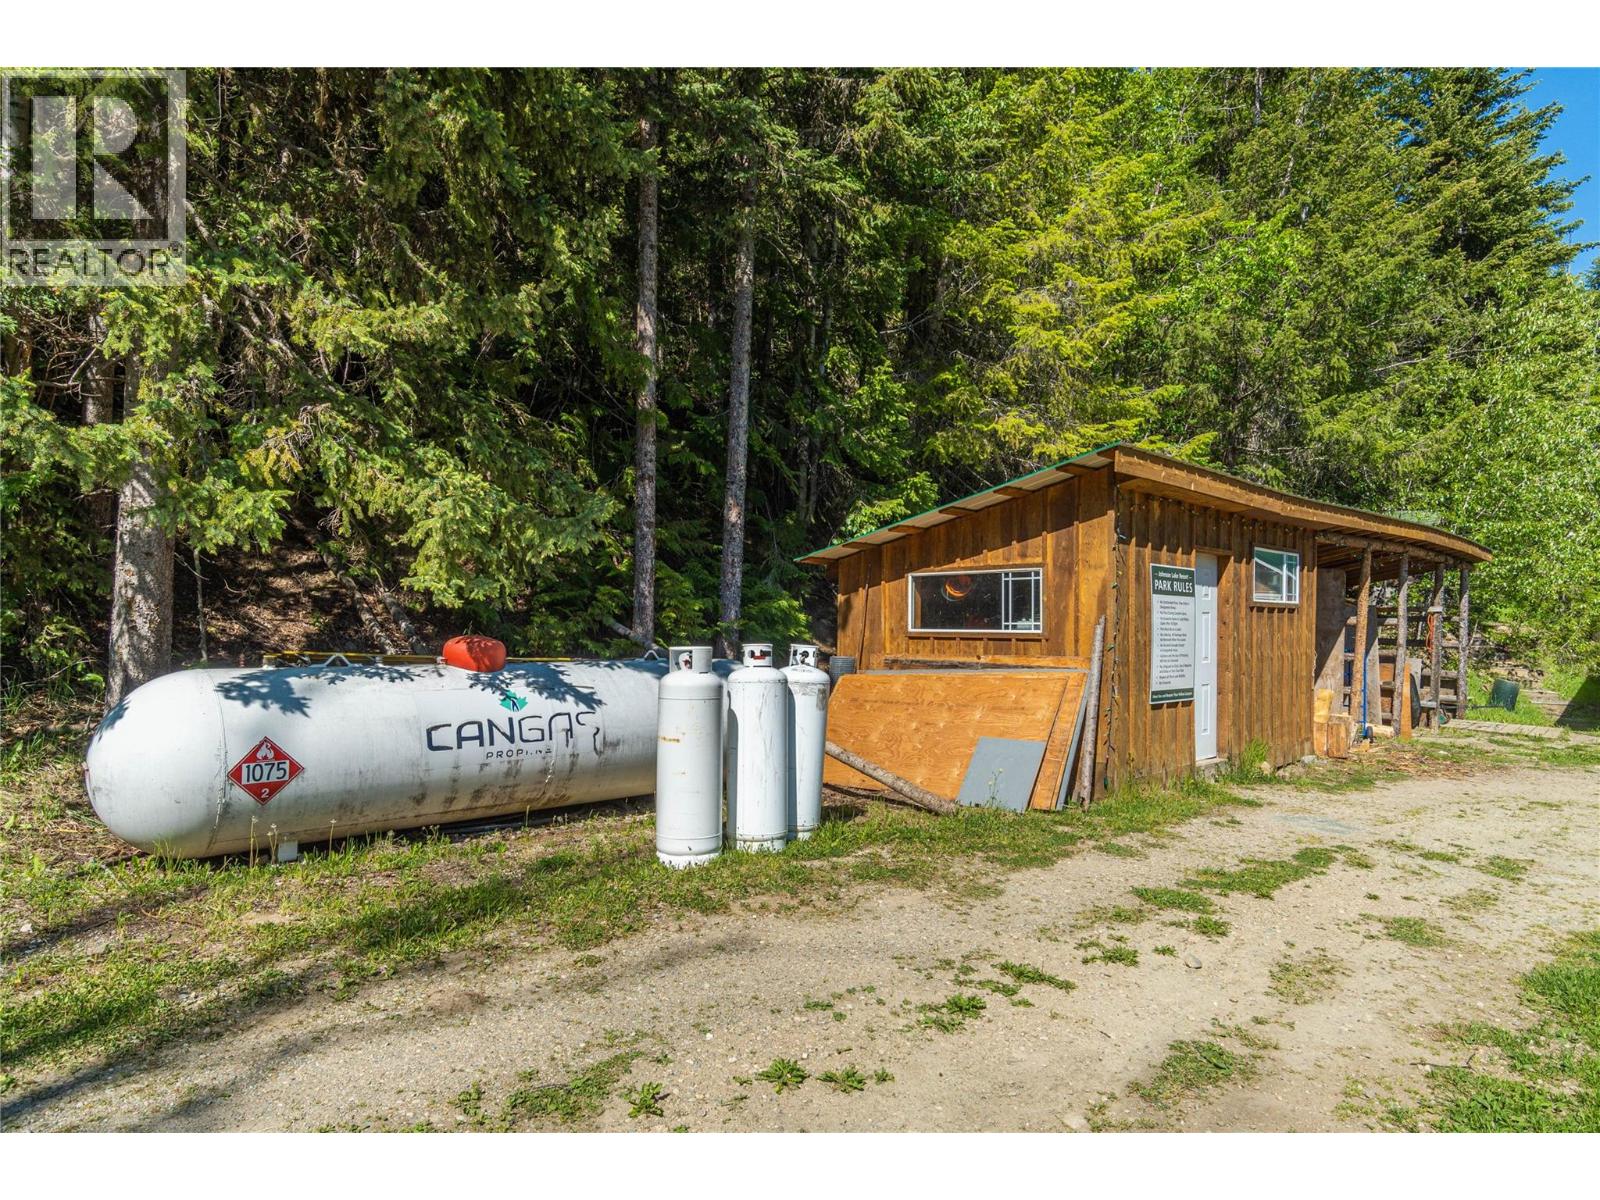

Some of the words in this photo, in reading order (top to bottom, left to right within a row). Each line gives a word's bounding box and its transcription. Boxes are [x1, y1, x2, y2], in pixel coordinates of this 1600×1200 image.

[1154, 579, 1172, 592] PARK
[1173, 581, 1193, 593] RULES
[245, 761, 287, 783] 1075
[261, 788, 270, 799] 2
